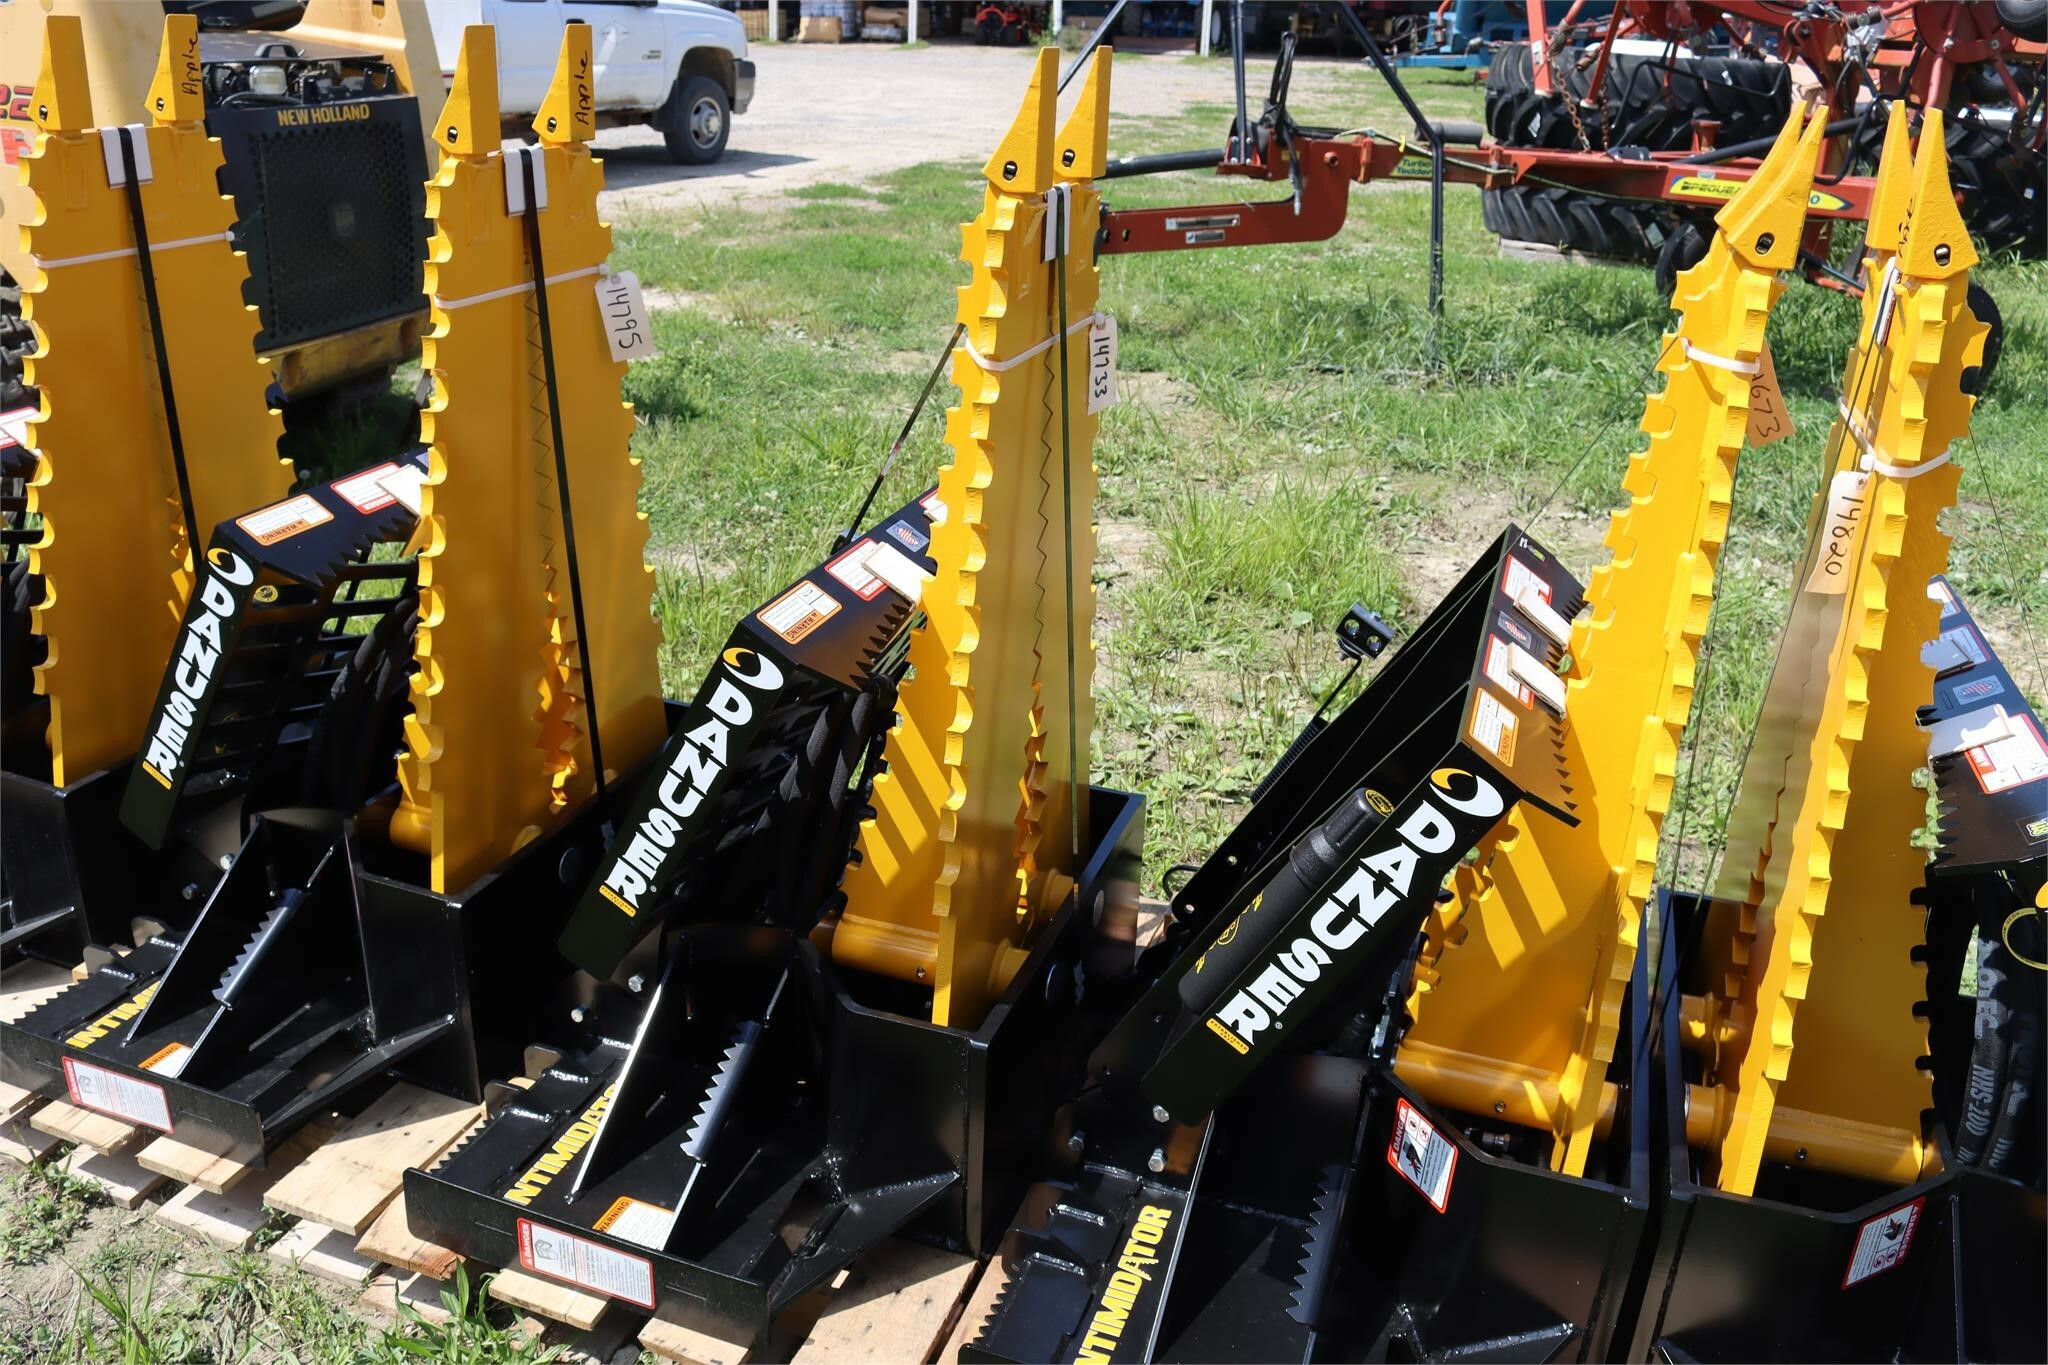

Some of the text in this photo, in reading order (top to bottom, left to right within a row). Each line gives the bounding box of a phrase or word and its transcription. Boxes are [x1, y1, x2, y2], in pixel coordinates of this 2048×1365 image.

[277, 104, 370, 126] NEW HOLLAND
[574, 50, 591, 125] Apple
[606, 287, 643, 349] 14795
[1093, 337, 1110, 398] 14733
[1824, 496, 1864, 576] 14820
[786, 616, 815, 639] WARNING
[145, 574, 236, 783] DANUSER
[604, 677, 753, 908] DANUSER
[1215, 800, 1456, 1046] DANUSER
[1393, 1106, 1408, 1152] DANGER
[521, 1223, 533, 1258] DANGER
